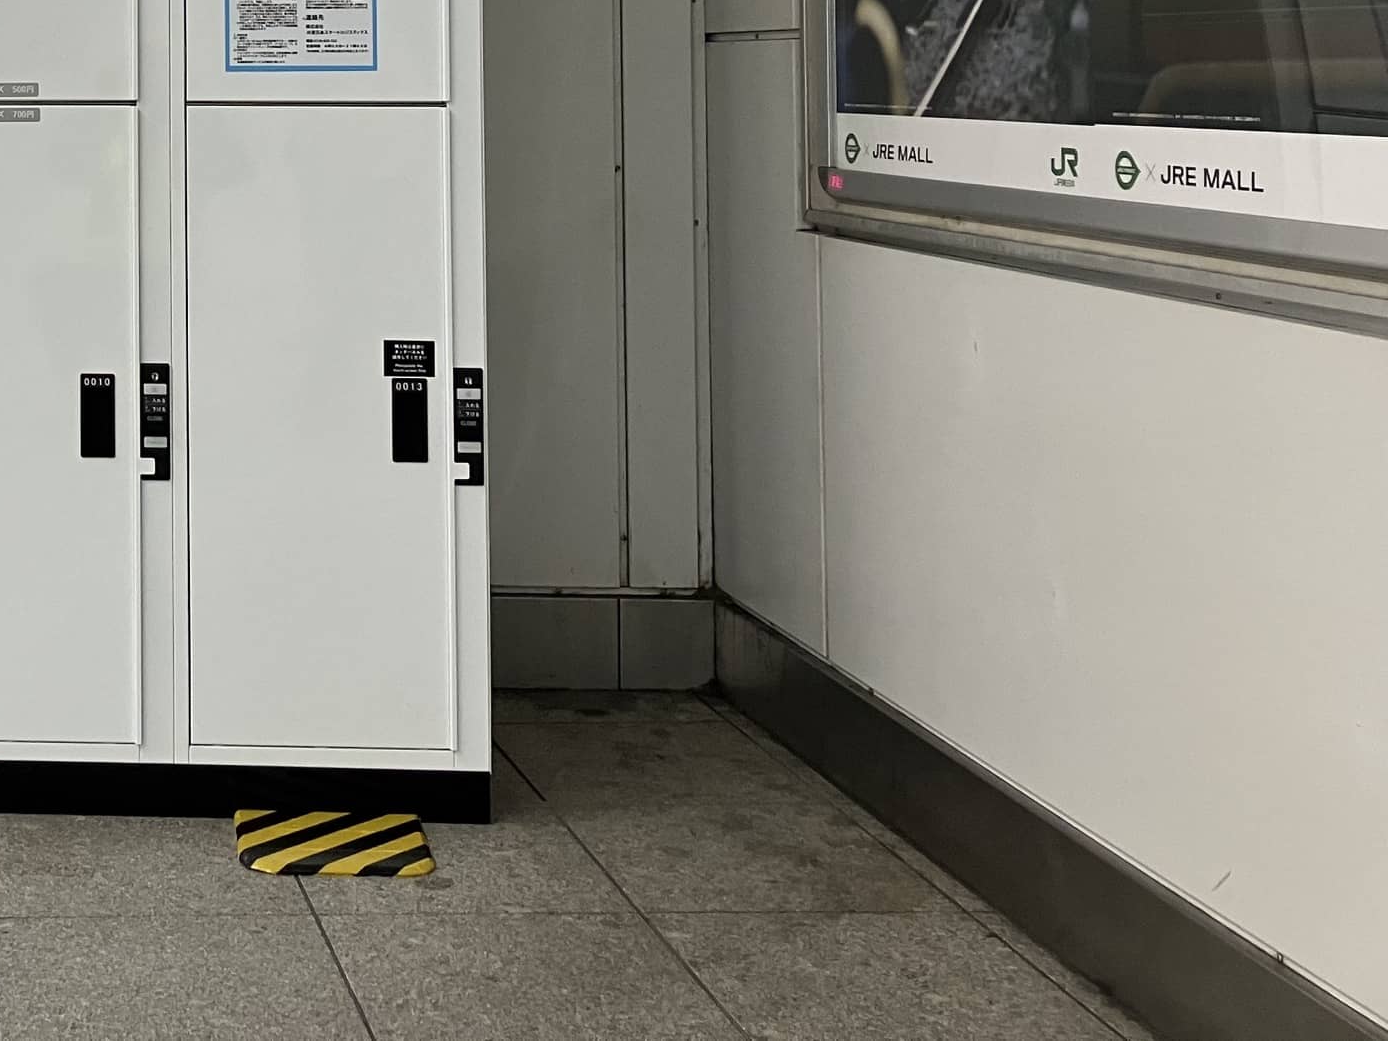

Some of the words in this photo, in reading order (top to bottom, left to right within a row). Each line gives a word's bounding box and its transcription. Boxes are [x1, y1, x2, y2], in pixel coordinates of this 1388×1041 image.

[13, 110, 35, 119] 700円
[872, 143, 895, 160] JRE
[898, 145, 934, 164] MALL
[1050, 146, 1079, 177] JR
[1161, 165, 1197, 187] JRE
[1203, 168, 1265, 193] MALL
[83, 378, 110, 386] 0010
[395, 382, 423, 391] 0013
